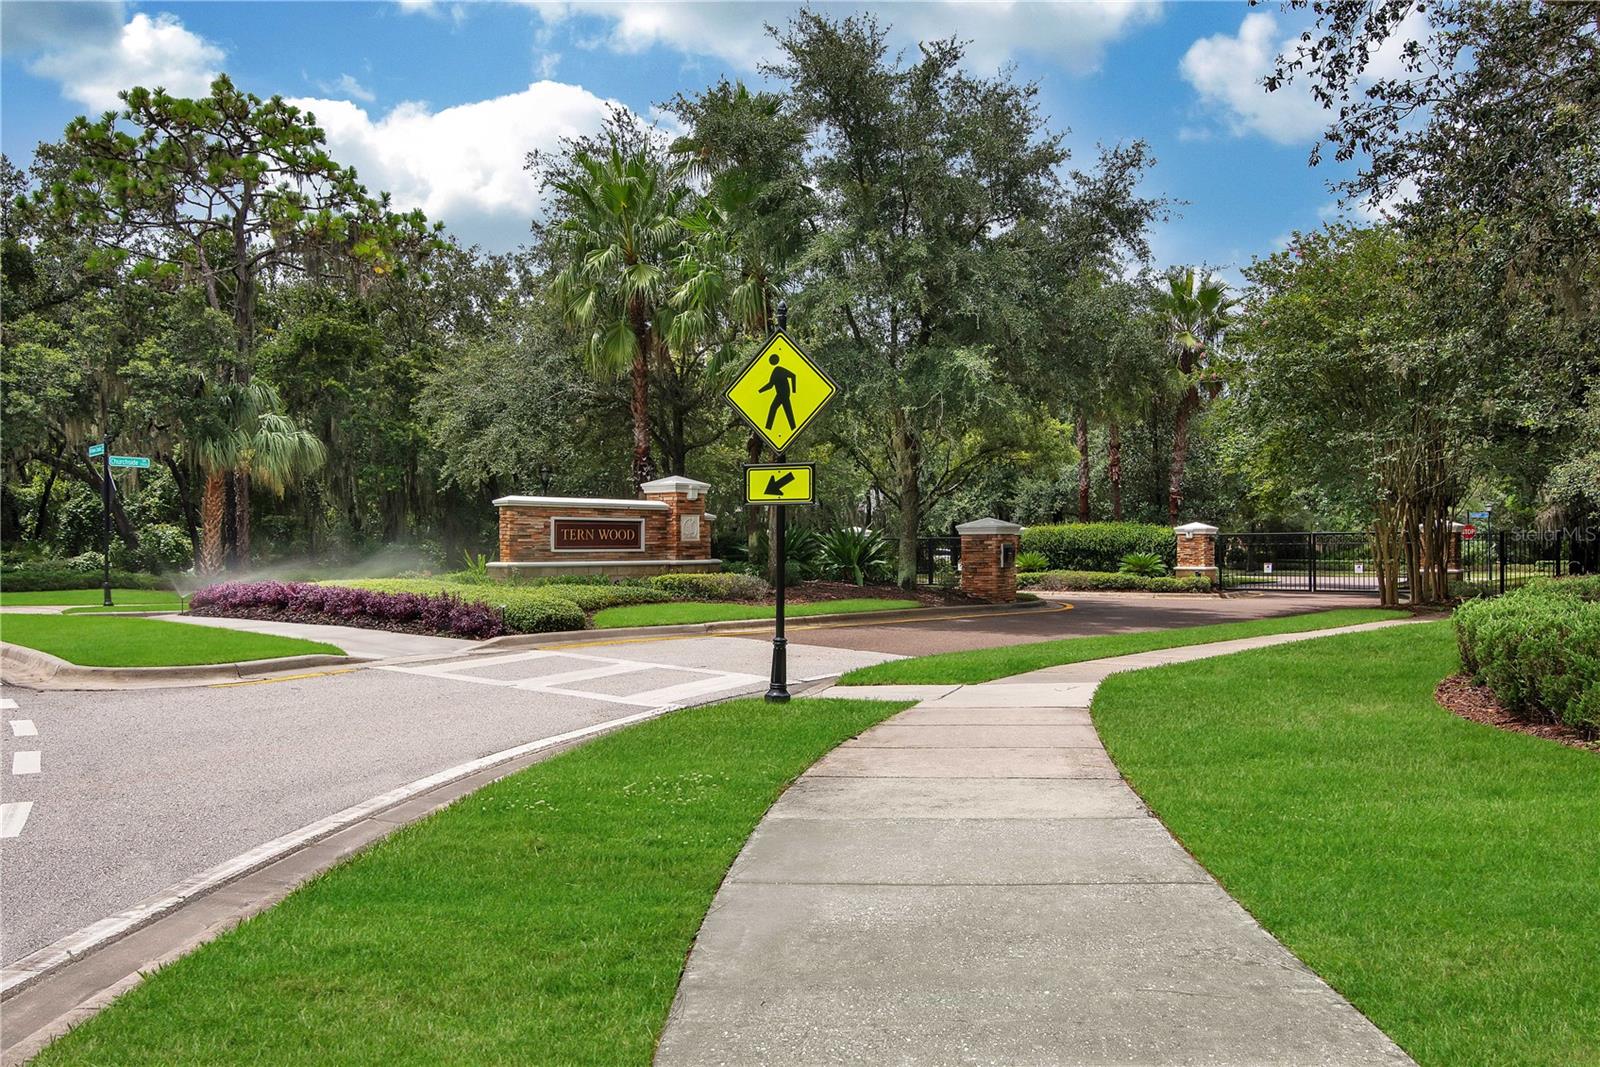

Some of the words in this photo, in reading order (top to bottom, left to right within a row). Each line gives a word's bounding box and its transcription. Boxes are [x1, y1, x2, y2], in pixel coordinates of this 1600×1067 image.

[111, 458, 138, 466] Churchside
[561, 529, 594, 540] TERN
[598, 529, 635, 540] WOOD
